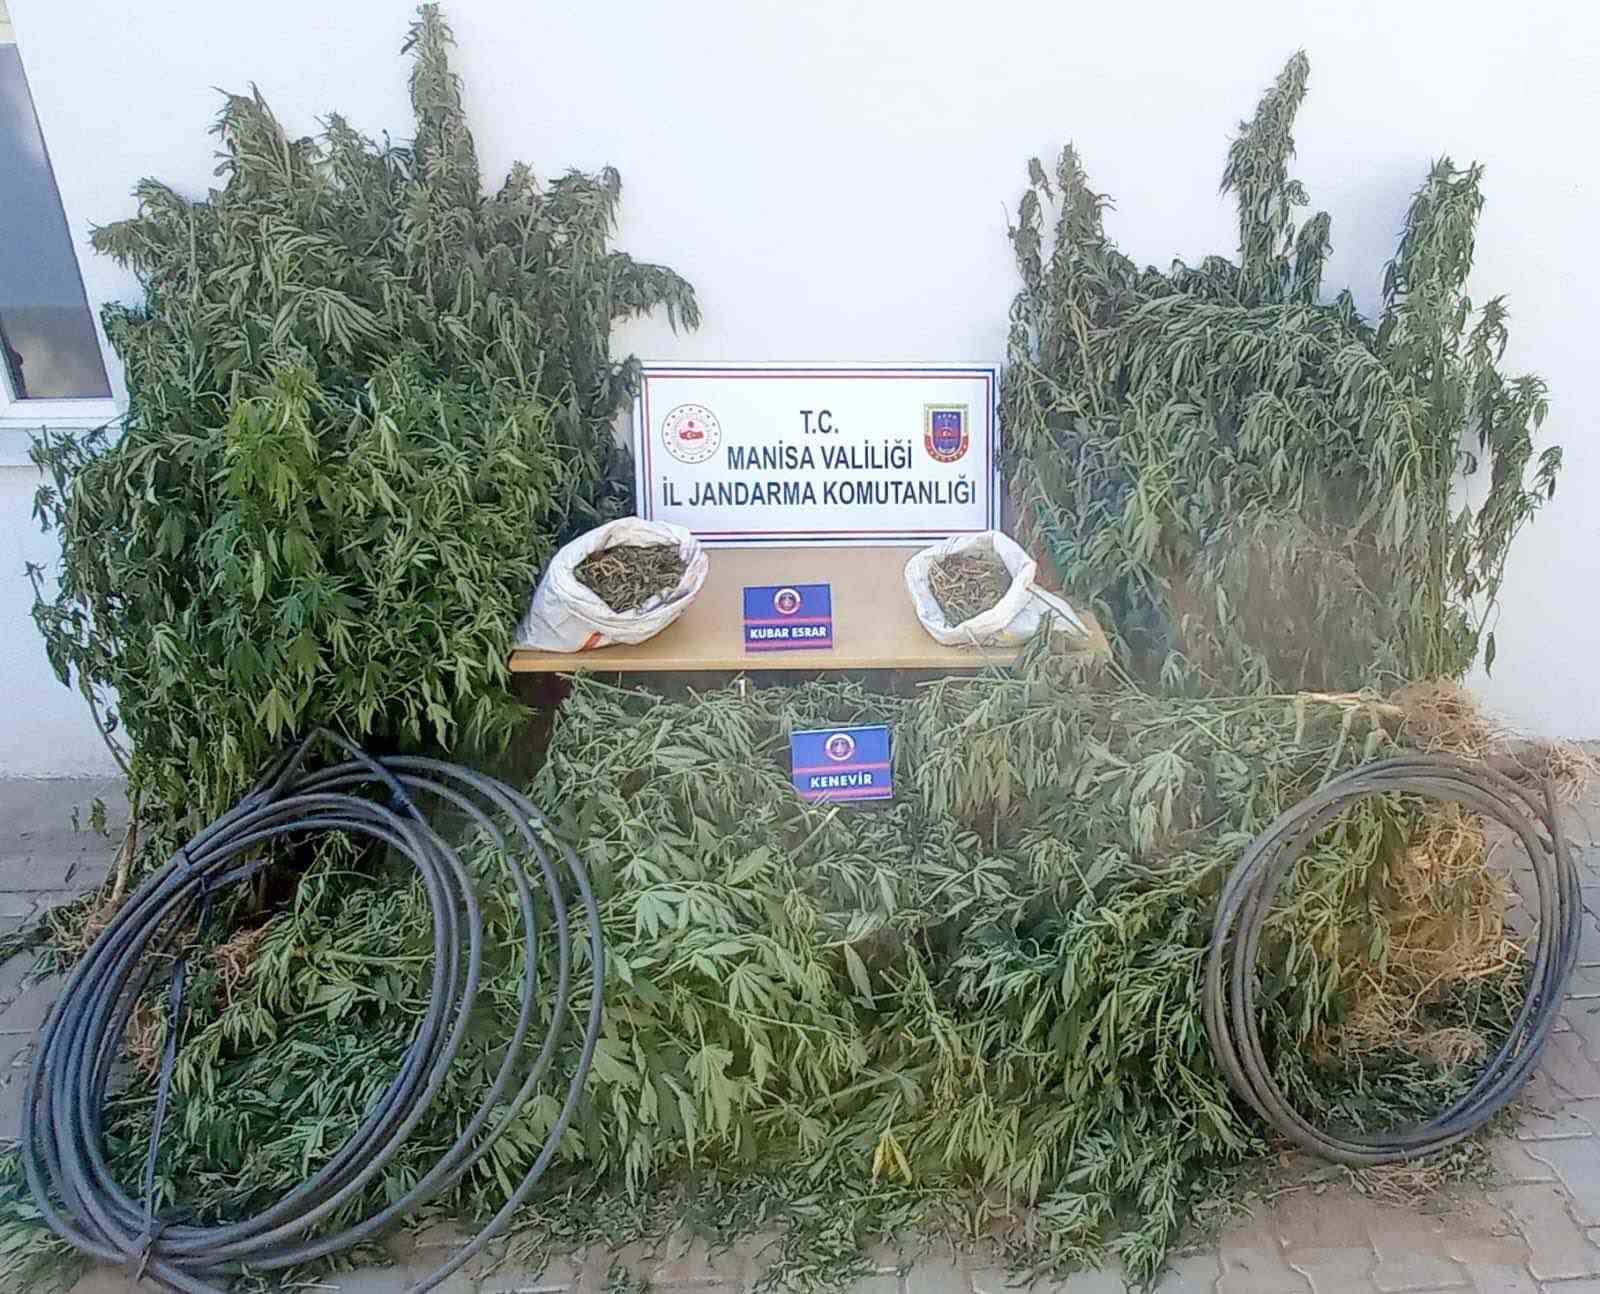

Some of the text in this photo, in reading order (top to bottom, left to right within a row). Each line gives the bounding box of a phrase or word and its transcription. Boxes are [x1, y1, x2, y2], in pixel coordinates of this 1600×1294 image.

[798, 410, 839, 434] T.C.
[727, 440, 815, 470] MANİSA
[821, 439, 912, 469] VALİLİĞİ
[663, 474, 976, 506] İL JANDARMA KOMUTANLIĞI
[750, 626, 827, 639] KUBAR ESRAR
[810, 771, 873, 788] KENEVİR
